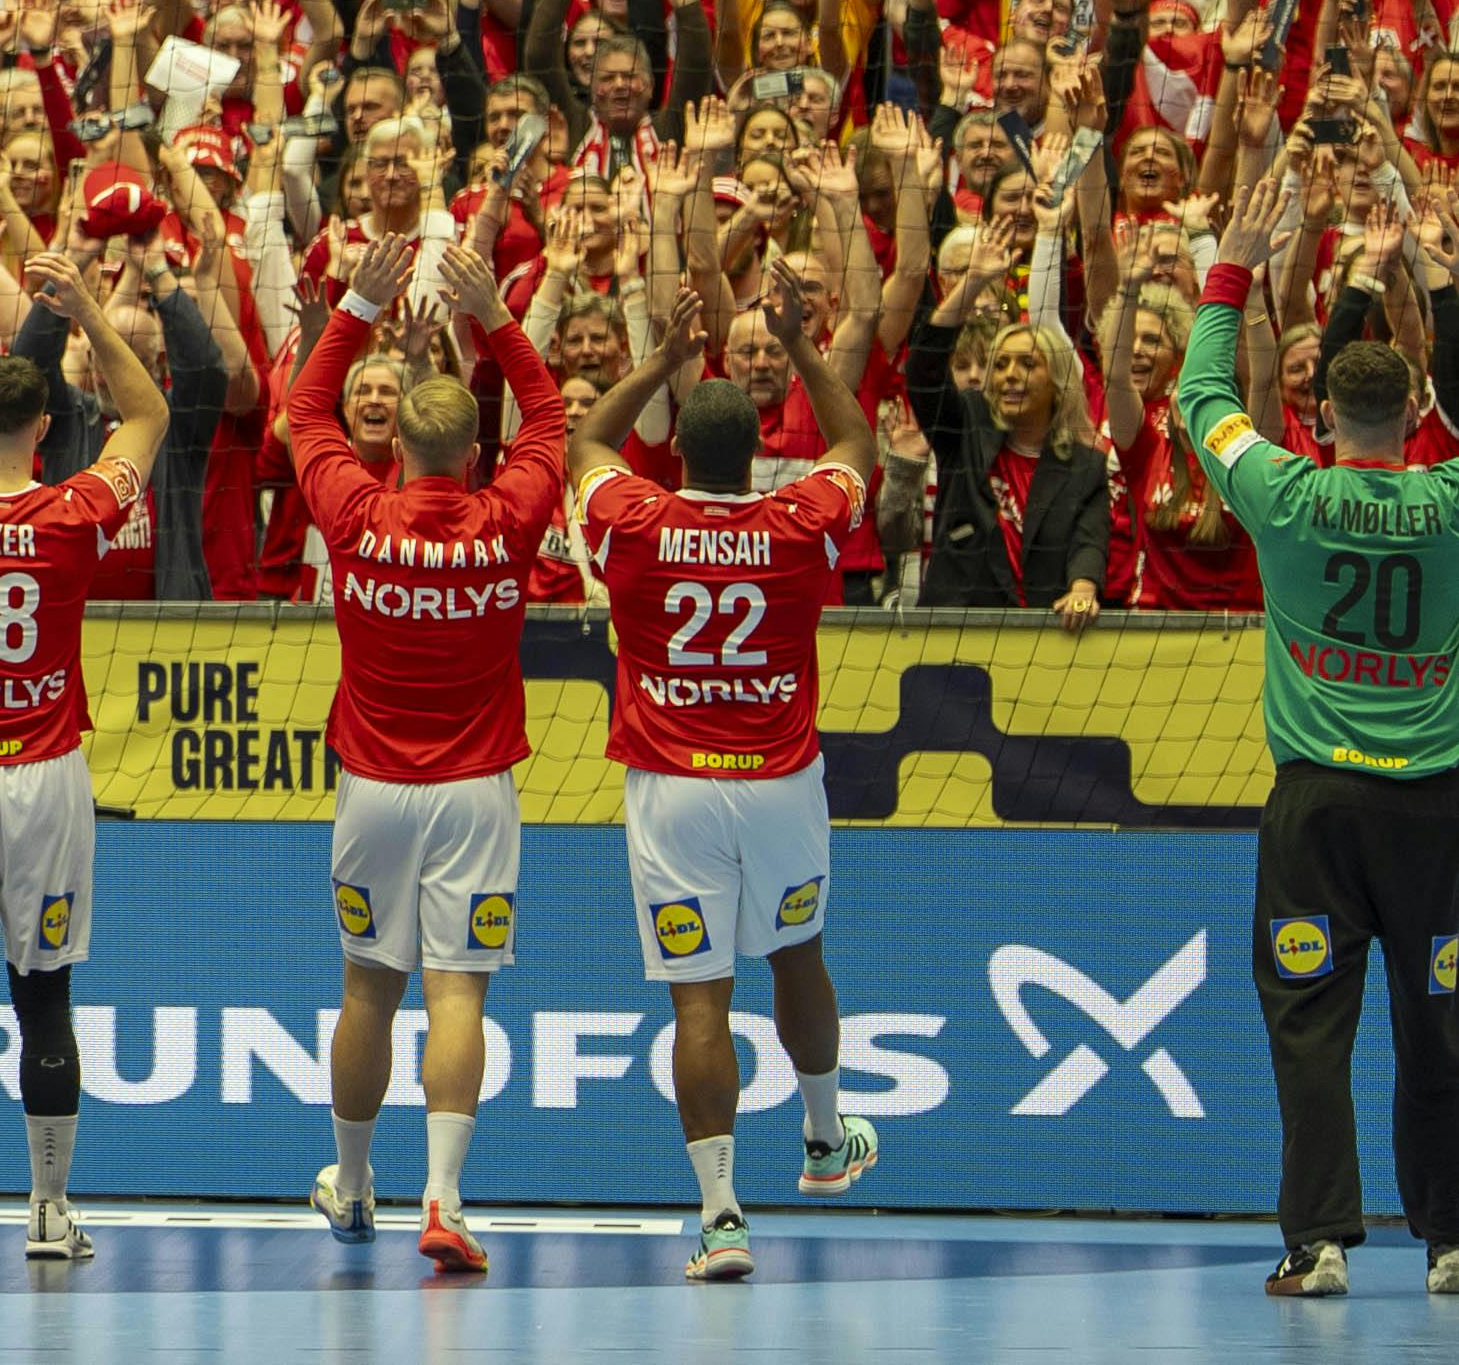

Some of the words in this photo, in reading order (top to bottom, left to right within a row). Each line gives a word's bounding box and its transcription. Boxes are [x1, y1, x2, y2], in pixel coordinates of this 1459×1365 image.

[358, 532, 510, 570] DANMARK
[658, 526, 772, 567] MENSAH
[343, 571, 520, 621] NORLYS
[1323, 551, 1423, 652] 20
[664, 581, 768, 667] 22
[1287, 640, 1451, 689] NORLYS
[137, 661, 259, 723] PURE
[691, 752, 765, 771] BORUP
[1331, 746, 1409, 770] BORUP
